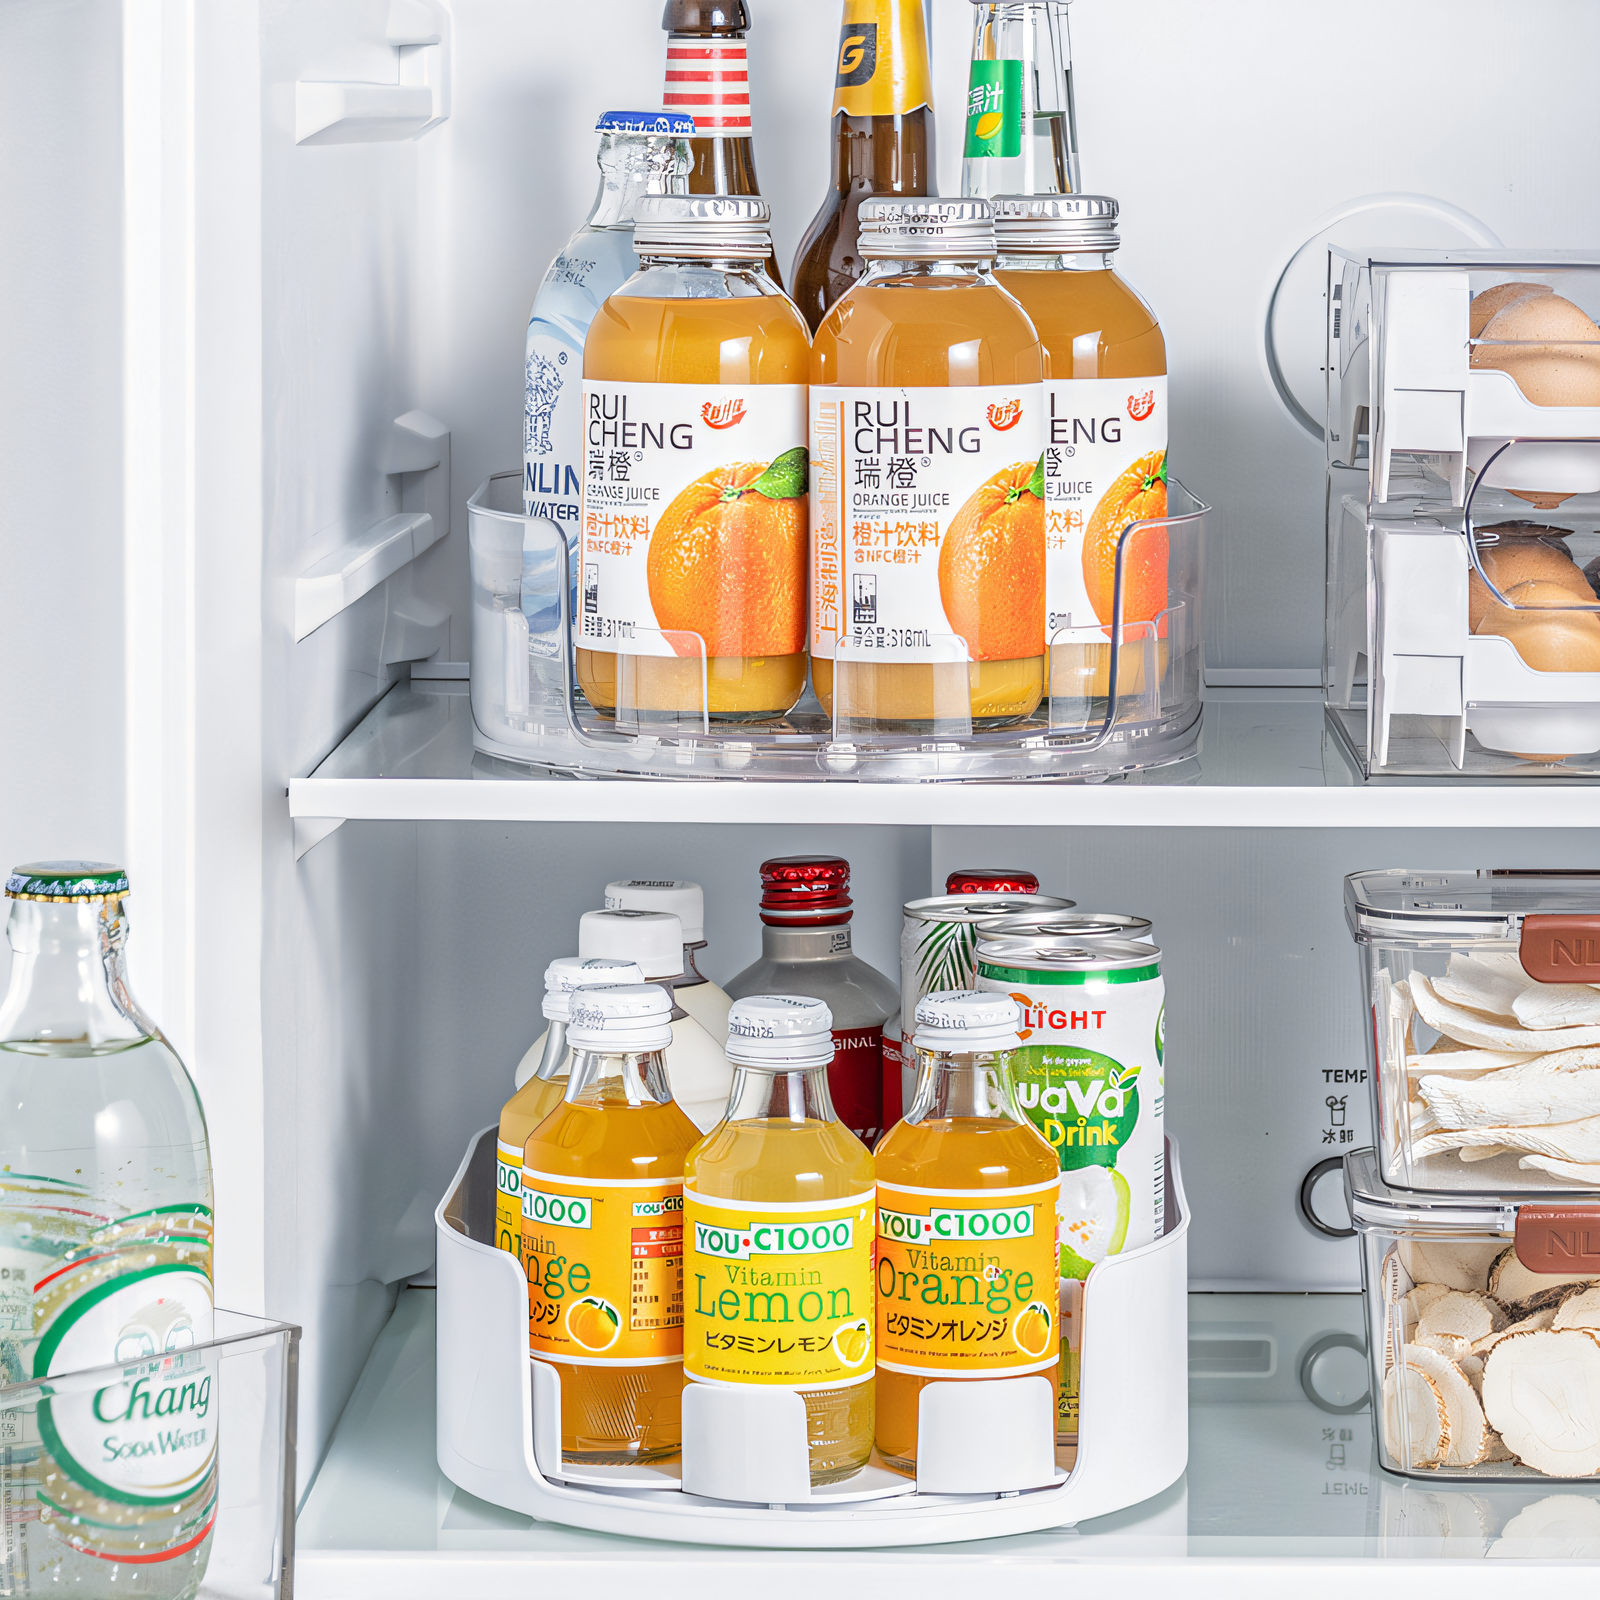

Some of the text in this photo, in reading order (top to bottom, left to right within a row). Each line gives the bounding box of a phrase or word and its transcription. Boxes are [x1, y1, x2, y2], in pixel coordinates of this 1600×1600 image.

[590, 393, 627, 420] RUI
[854, 400, 909, 427] RUI
[589, 420, 693, 449] CHENG
[854, 427, 980, 454] CHENG
[1050, 417, 1121, 444] ENG
[854, 457, 918, 489] 瑞橙
[853, 493, 950, 509] ORANGE JUICE
[1056, 482, 1093, 497] JUICE
[1024, 1010, 1107, 1030] LIGHT
[1044, 1117, 1119, 1147] Drink
[905, 1248, 1001, 1273] Vitamin
[724, 1264, 823, 1287] Vitamin
[878, 1256, 1034, 1315] Orange
[695, 1273, 854, 1323] Lemon
[93, 1375, 211, 1423] Chang
